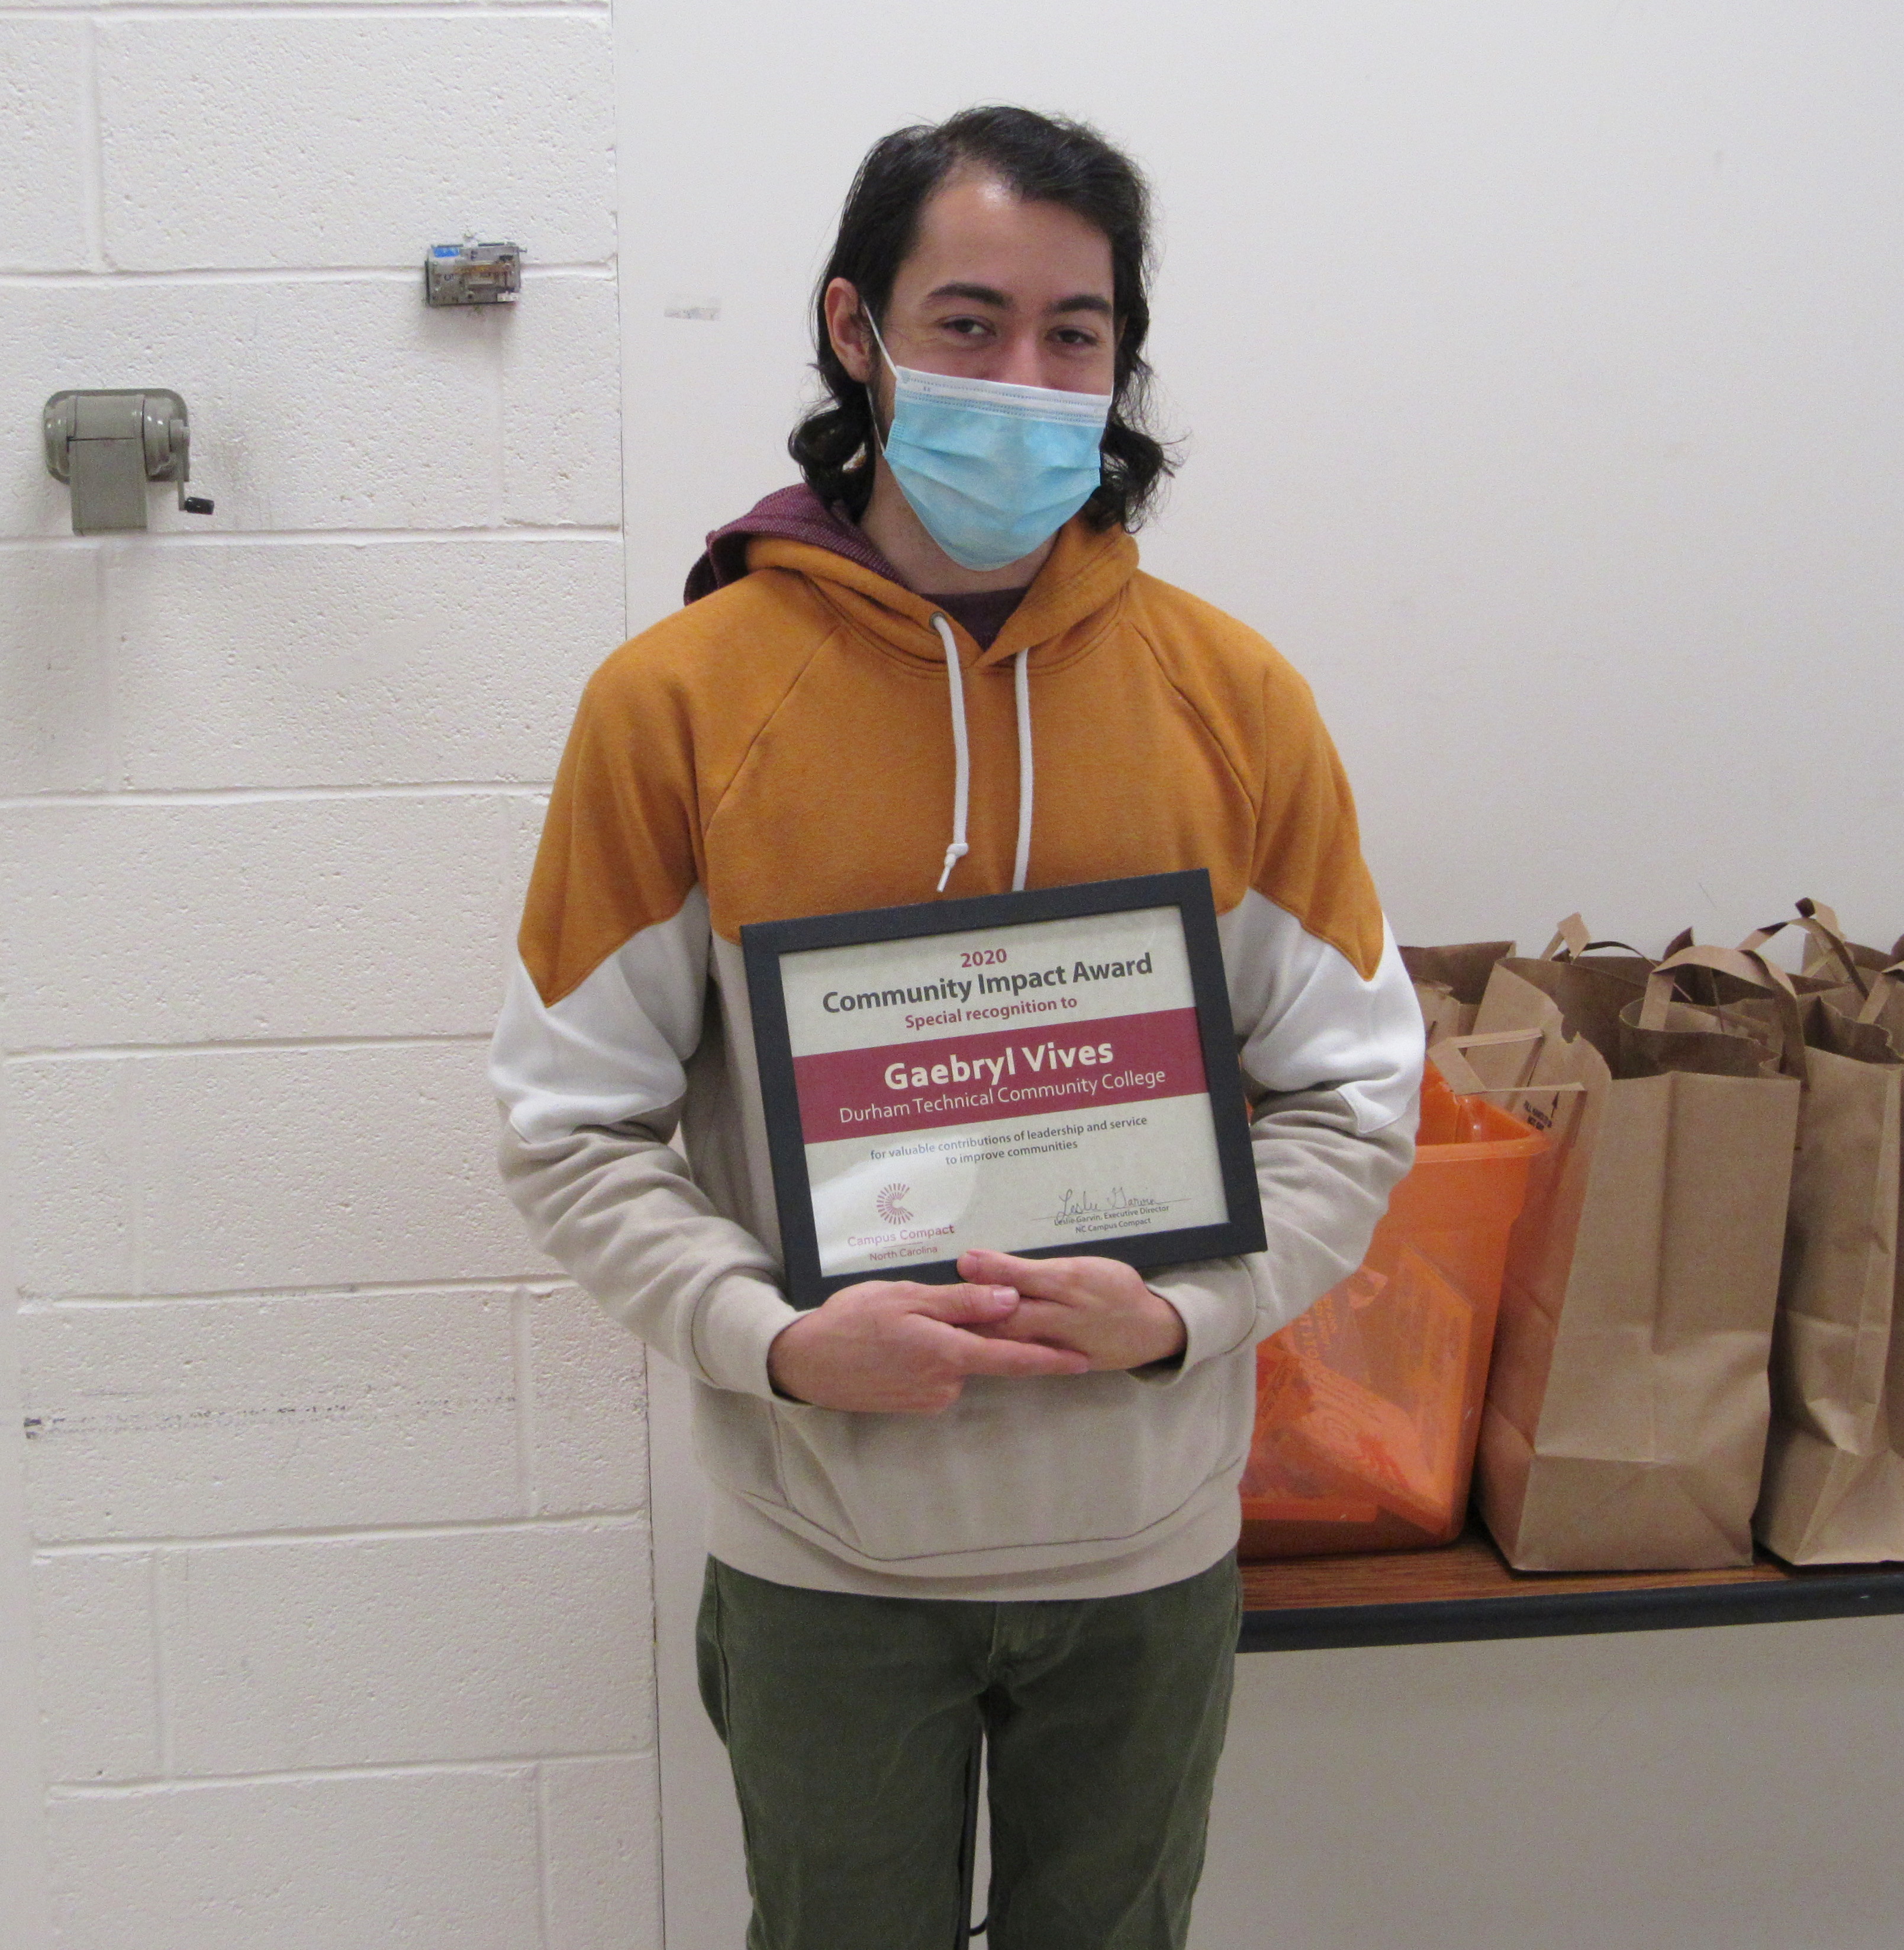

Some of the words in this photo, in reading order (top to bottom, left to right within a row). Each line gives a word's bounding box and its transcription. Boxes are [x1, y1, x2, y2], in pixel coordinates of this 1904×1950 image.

[960, 948, 1007, 968] 2020
[823, 978, 972, 1013] Community
[978, 966, 1067, 996] Impact
[1072, 952, 1153, 983] Award
[905, 1009, 962, 1030] Special
[966, 1000, 1057, 1021] recognition
[1061, 997, 1077, 1009] to
[884, 1047, 1016, 1089] Gaebryl
[1021, 1042, 1114, 1071] Vives
[840, 1103, 910, 1123] Durham
[912, 1088, 993, 1113] Technical
[997, 1078, 1098, 1103] Community
[1101, 1070, 1166, 1089] College
[871, 1150, 885, 1160] for
[889, 1143, 935, 1157] valuable
[938, 1134, 1011, 1151] contributions
[1014, 1130, 1026, 1142] of
[1027, 1124, 1084, 1140] leadership
[1087, 1120, 1107, 1132] and
[1110, 1116, 1147, 1129] service
[945, 1156, 957, 1165] to
[959, 1150, 1005, 1164] improve
[1007, 1140, 1078, 1157] communities
[1054, 1217, 1075, 1227] Leslie
[1104, 1209, 1139, 1220] Executive
[1140, 1205, 1170, 1215] Director
[1075, 1225, 1087, 1233] NC
[1088, 1222, 1117, 1232] Campus
[1119, 1218, 1151, 1229] Compact
[847, 1234, 897, 1247] Campus
[900, 1224, 955, 1240] Compact
[869, 1250, 897, 1261] North
[900, 1246, 938, 1257] Carolina
